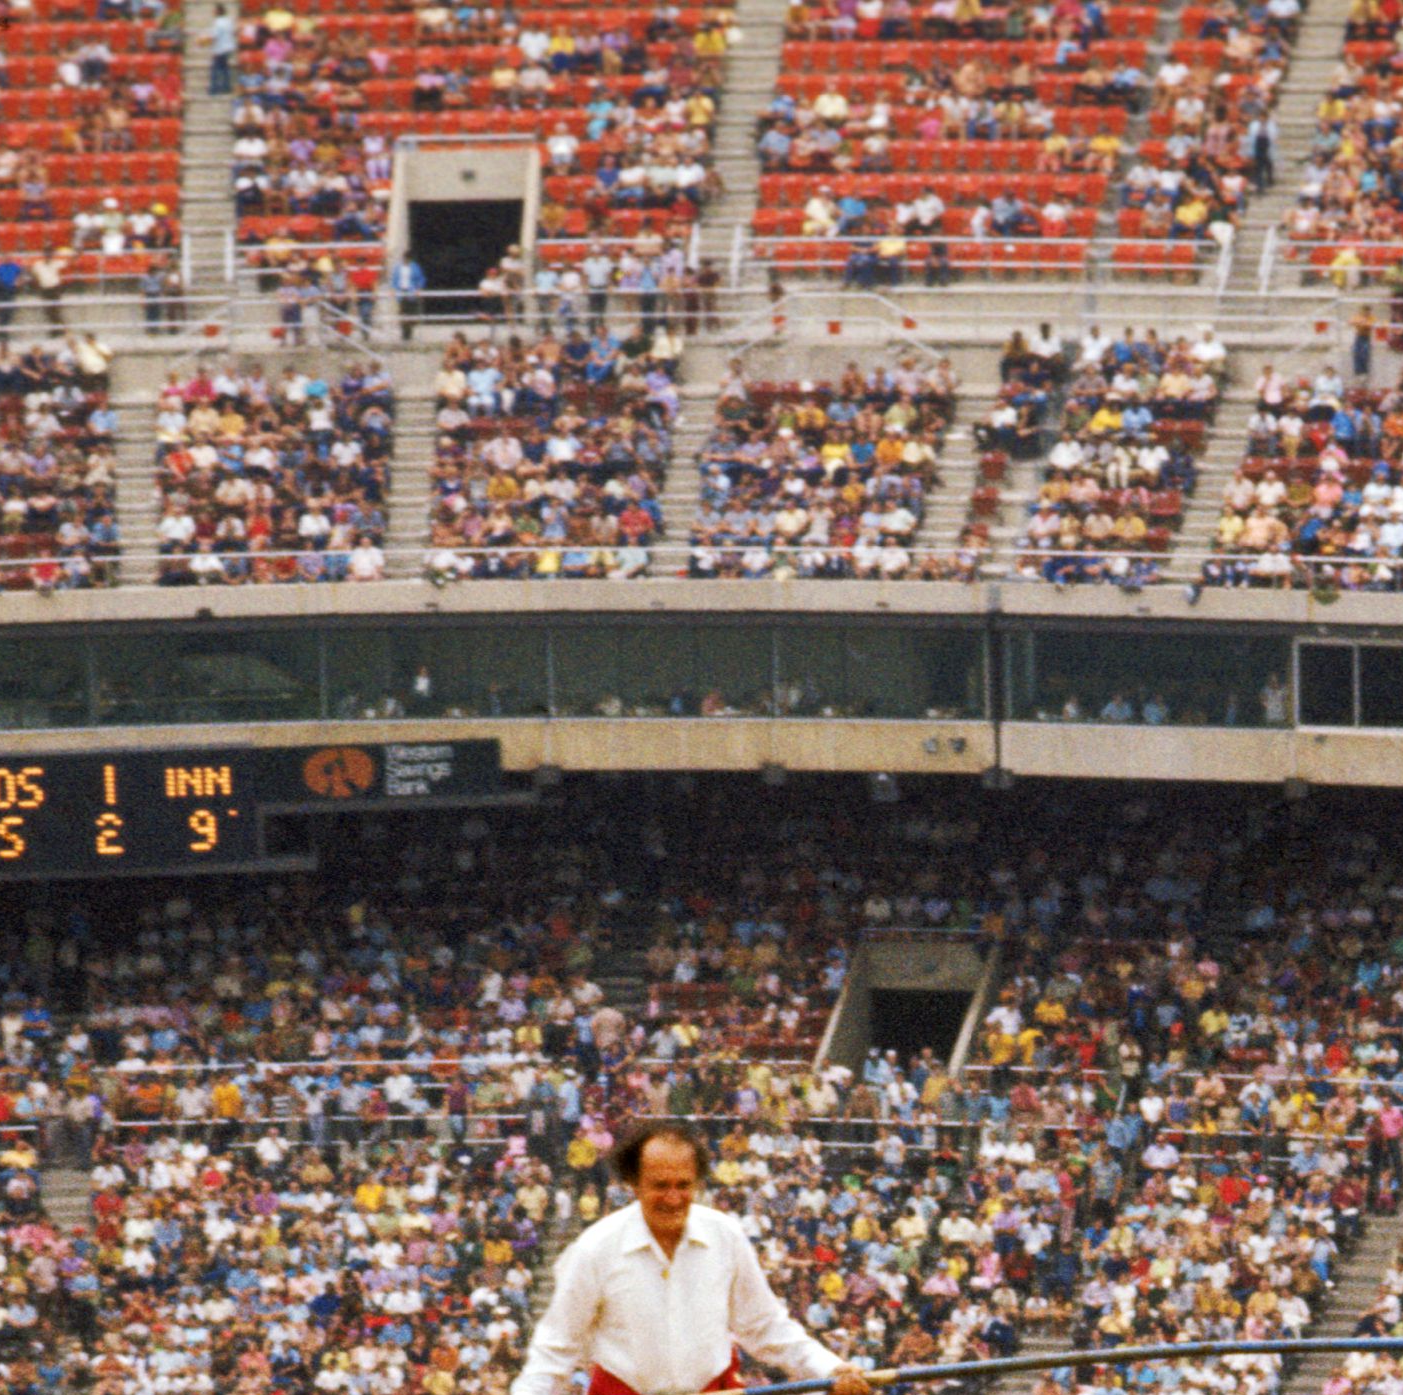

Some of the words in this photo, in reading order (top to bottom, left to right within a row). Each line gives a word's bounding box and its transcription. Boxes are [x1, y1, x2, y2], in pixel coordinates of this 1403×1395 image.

[103, 765, 116, 805] 1
[165, 766, 232, 797] INN
[96, 813, 124, 855] 2
[189, 809, 217, 851] 9
